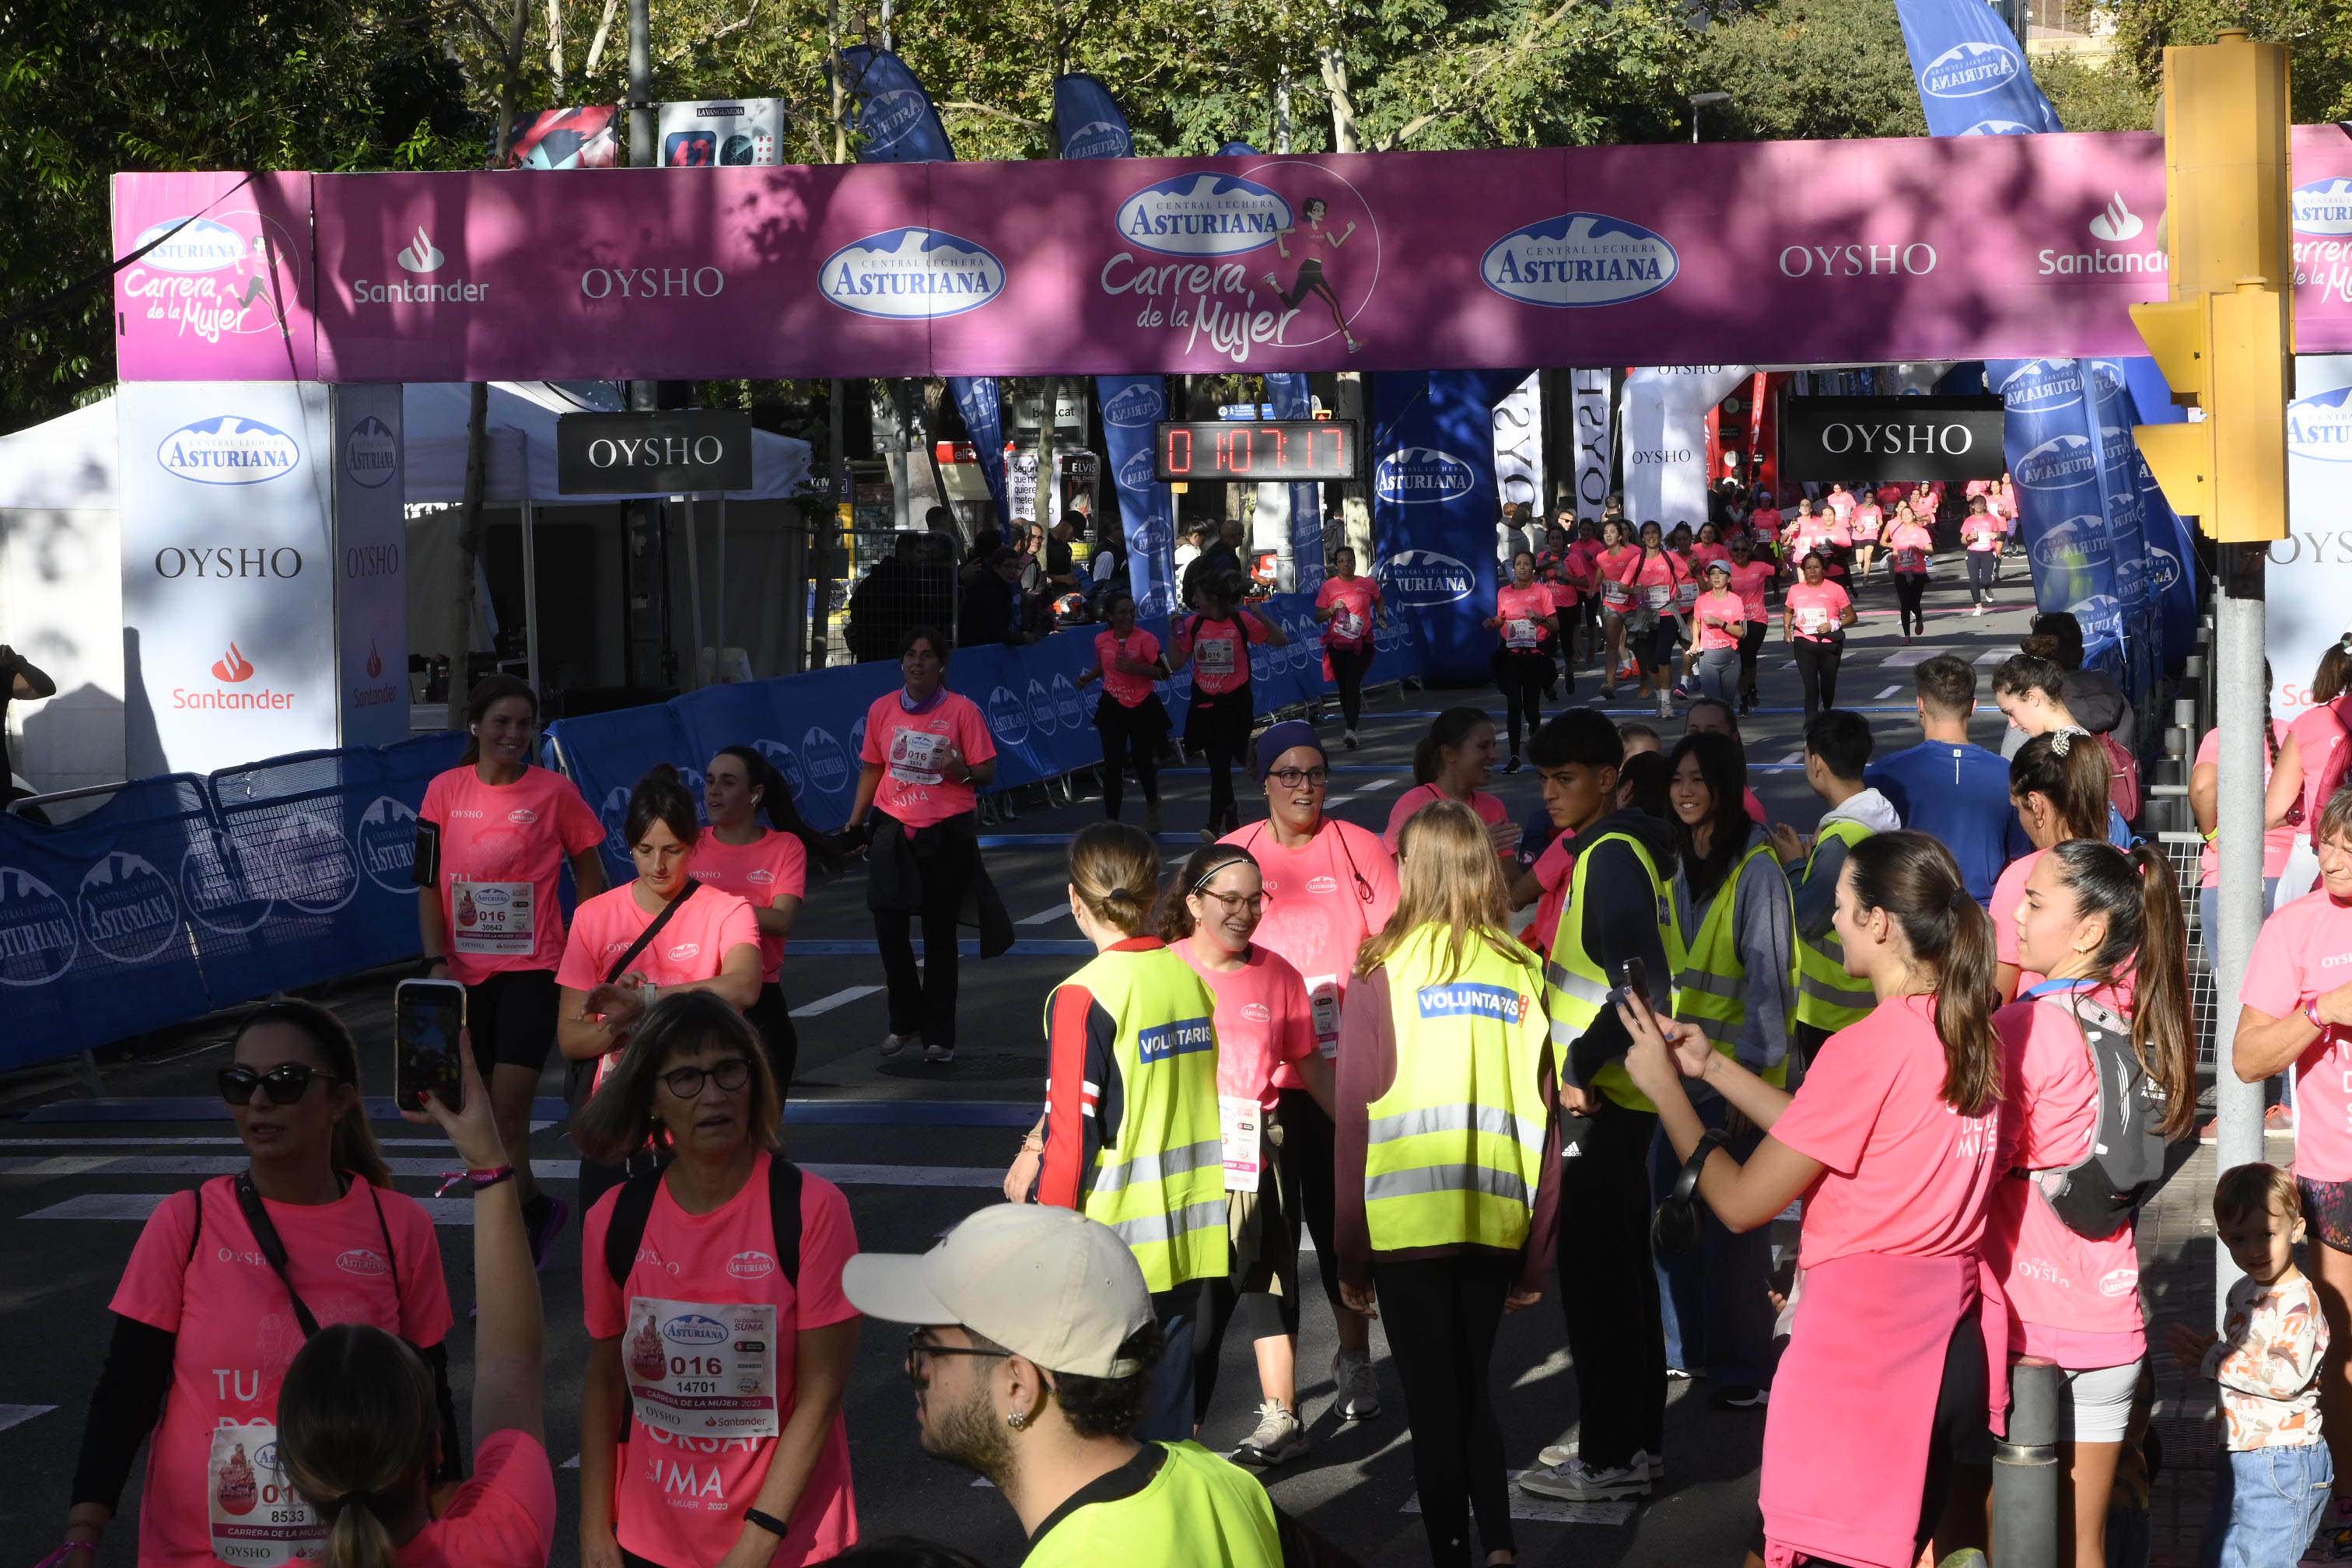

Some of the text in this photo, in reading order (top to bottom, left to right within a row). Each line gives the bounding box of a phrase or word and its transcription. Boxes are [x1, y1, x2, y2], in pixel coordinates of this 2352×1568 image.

[1157, 200, 1274, 210] CENTRAL LECHERA
[1129, 204, 1278, 236] ASTURIANA
[1526, 245, 1657, 256] CENTRAL LECHERA
[1780, 243, 1937, 277] OYSHO
[861, 256, 985, 268] CENTRAL LECHERA
[1496, 249, 1664, 284] ASTURIANA
[124, 268, 215, 298] Carrera
[581, 267, 724, 299] OYSHO
[832, 262, 991, 296] ASTURIANA
[1101, 252, 1248, 296] Carrera
[354, 278, 489, 304] Santander
[147, 296, 250, 343] de la Mujer
[1137, 290, 1300, 362] de la Mujer
[1822, 423, 1972, 455] OYSHO
[168, 441, 289, 467] ASTURIANA
[588, 436, 723, 467] OYSHO
[1633, 449, 1690, 464] OYSHO
[1073, 463, 1095, 472] ELVIS
[1379, 470, 1466, 491] ASTURIANA
[155, 548, 302, 578] OYSHO
[347, 544, 397, 579] OYSHO
[173, 689, 294, 709] Santander
[908, 751, 927, 760] 016
[892, 789, 929, 807] SUMA
[452, 810, 483, 818] OYSHO
[689, 870, 720, 879] OYSHO
[86, 894, 176, 941] ASTURIANA
[479, 911, 506, 921] 016
[1420, 991, 1519, 1016] VOLUNTARIS
[1141, 1026, 1212, 1055] VOLUNTARIS
[729, 1260, 771, 1274] ASTURIANA
[668, 1324, 723, 1339] ASTURIANA
[671, 1356, 722, 1375] 016
[212, 1369, 260, 1401] TU
[677, 1381, 716, 1393] 14701
[646, 1391, 679, 1405] CARRERA
[646, 1406, 680, 1425] OYSHO
[718, 1417, 765, 1426] Santander
[708, 1502, 728, 1510] 2023
[271, 1510, 304, 1522] 8533
[227, 1528, 269, 1537] CARRERA
[225, 1545, 270, 1559] OYSHO
